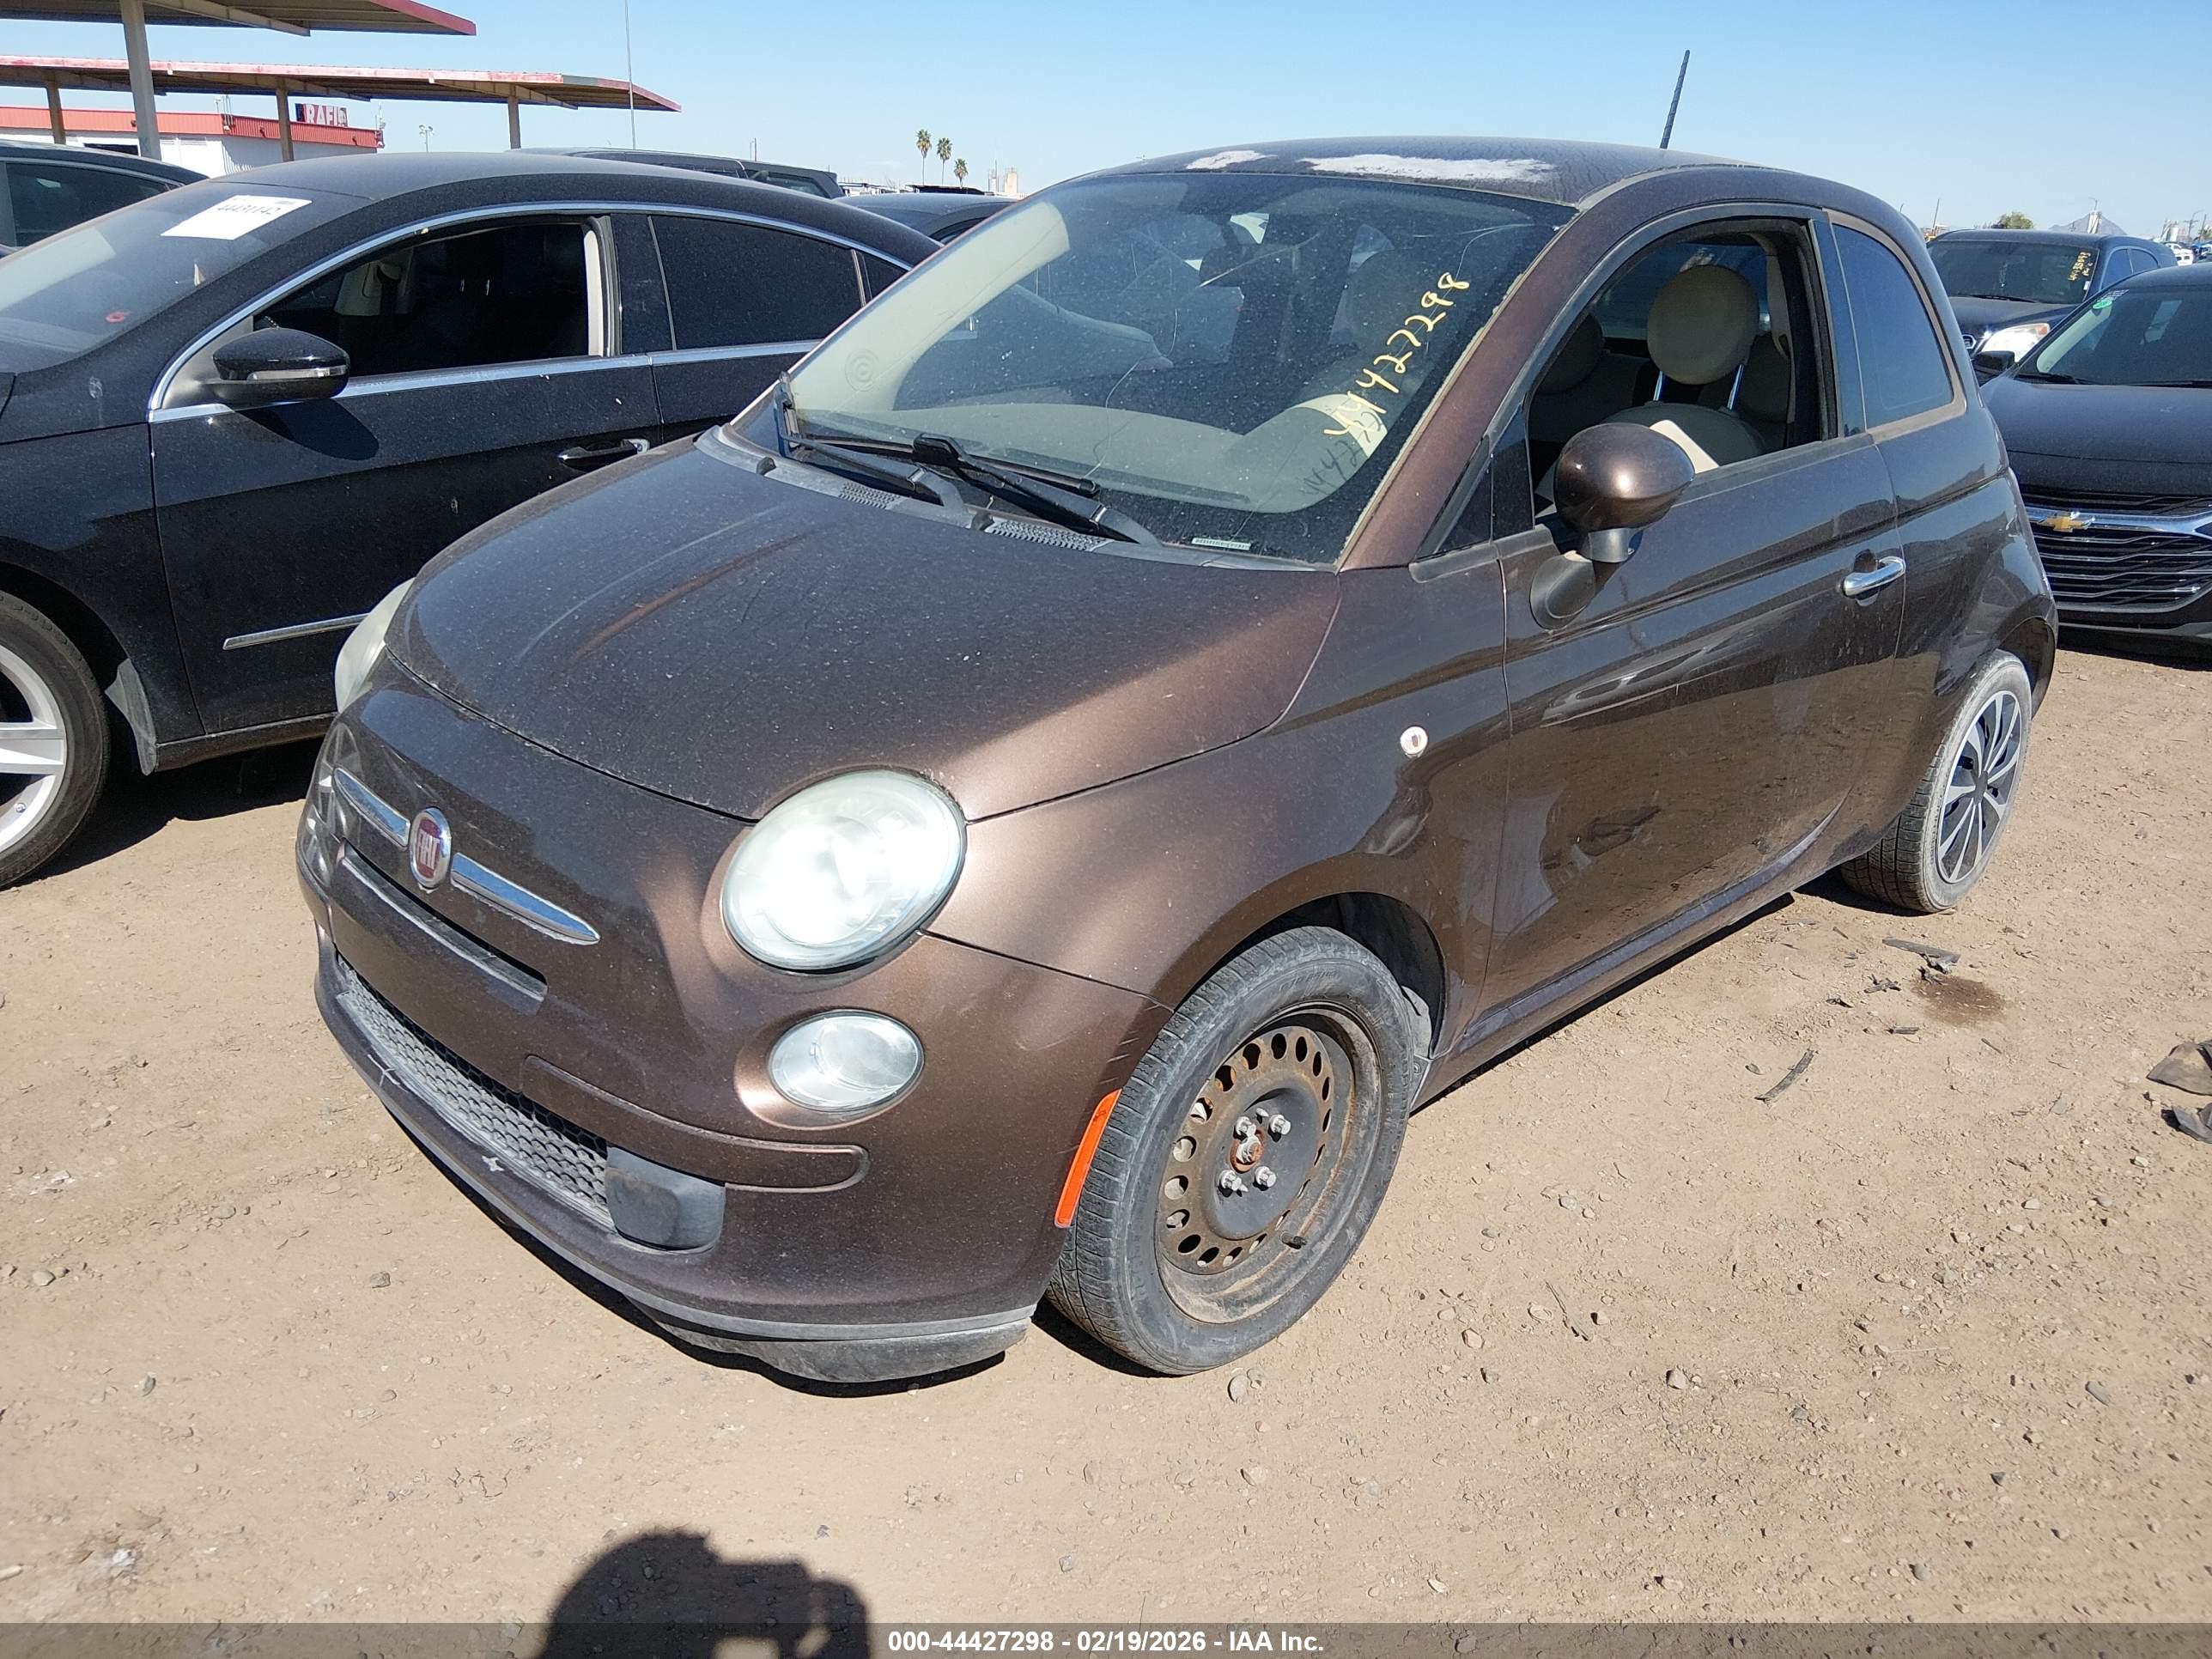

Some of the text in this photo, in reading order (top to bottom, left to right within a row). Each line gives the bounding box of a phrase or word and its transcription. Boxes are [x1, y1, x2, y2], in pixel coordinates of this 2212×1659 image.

[306, 103, 338, 126] RAFI
[1323, 272, 1469, 435] 44427298
[416, 828, 441, 870] FIAT
